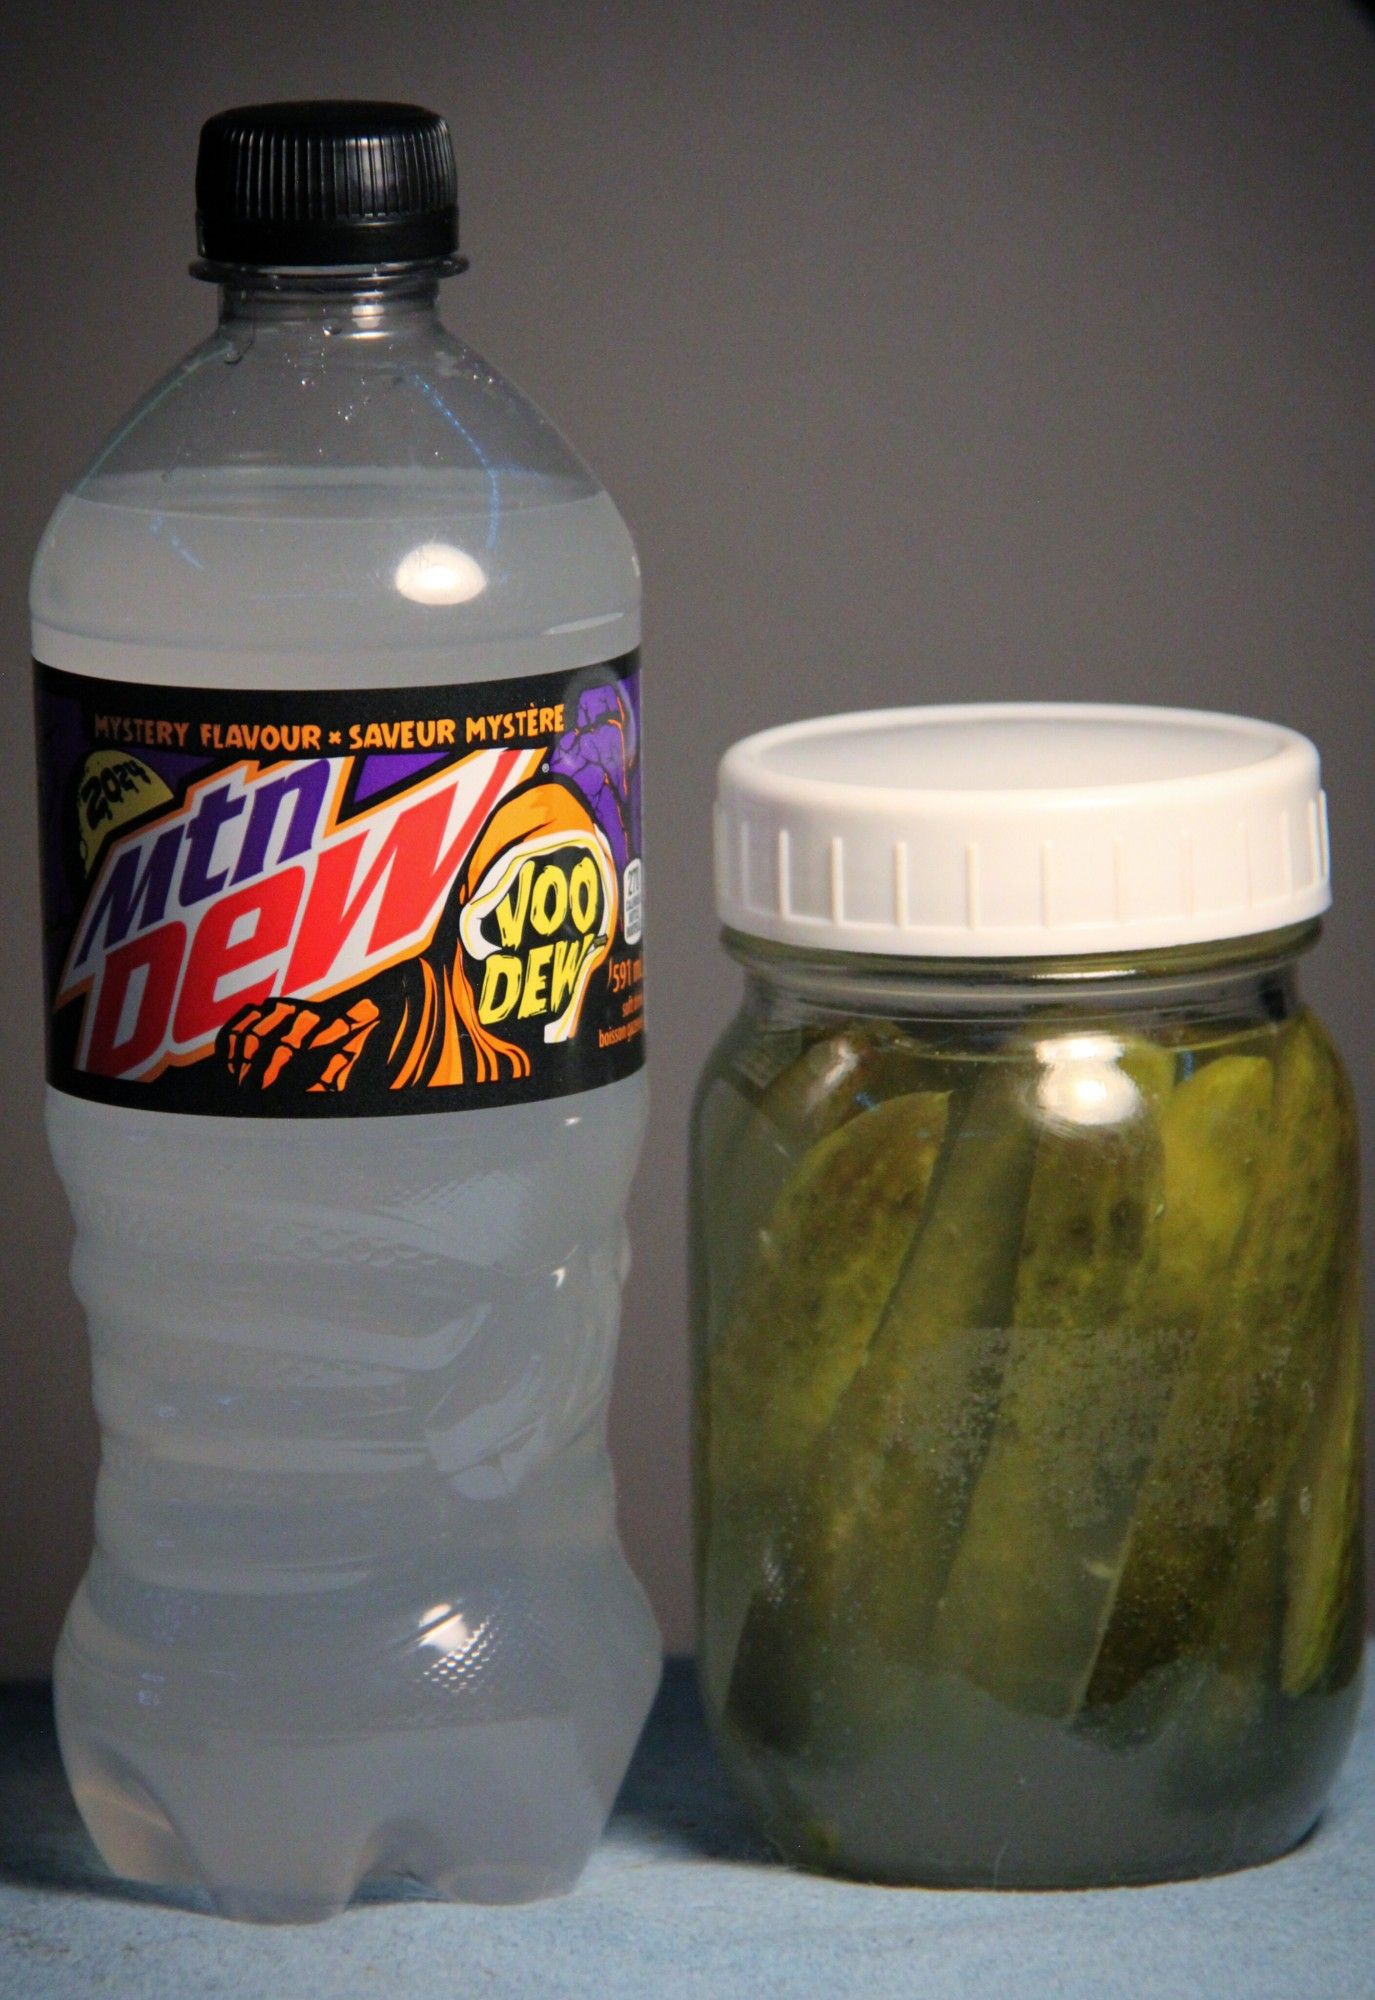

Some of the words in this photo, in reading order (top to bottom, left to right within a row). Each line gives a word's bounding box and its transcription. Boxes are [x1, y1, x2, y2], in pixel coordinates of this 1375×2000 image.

[95, 713, 190, 748] MYSTERY
[200, 723, 323, 751] FLAVOUR
[348, 718, 456, 750] SAVEUR
[465, 702, 565, 744] MYSTÈRE
[81, 759, 153, 831] 2024
[75, 758, 331, 968] Mtn
[495, 856, 599, 951] VOO
[478, 933, 596, 1026] DEW
[612, 958, 632, 993] 591
